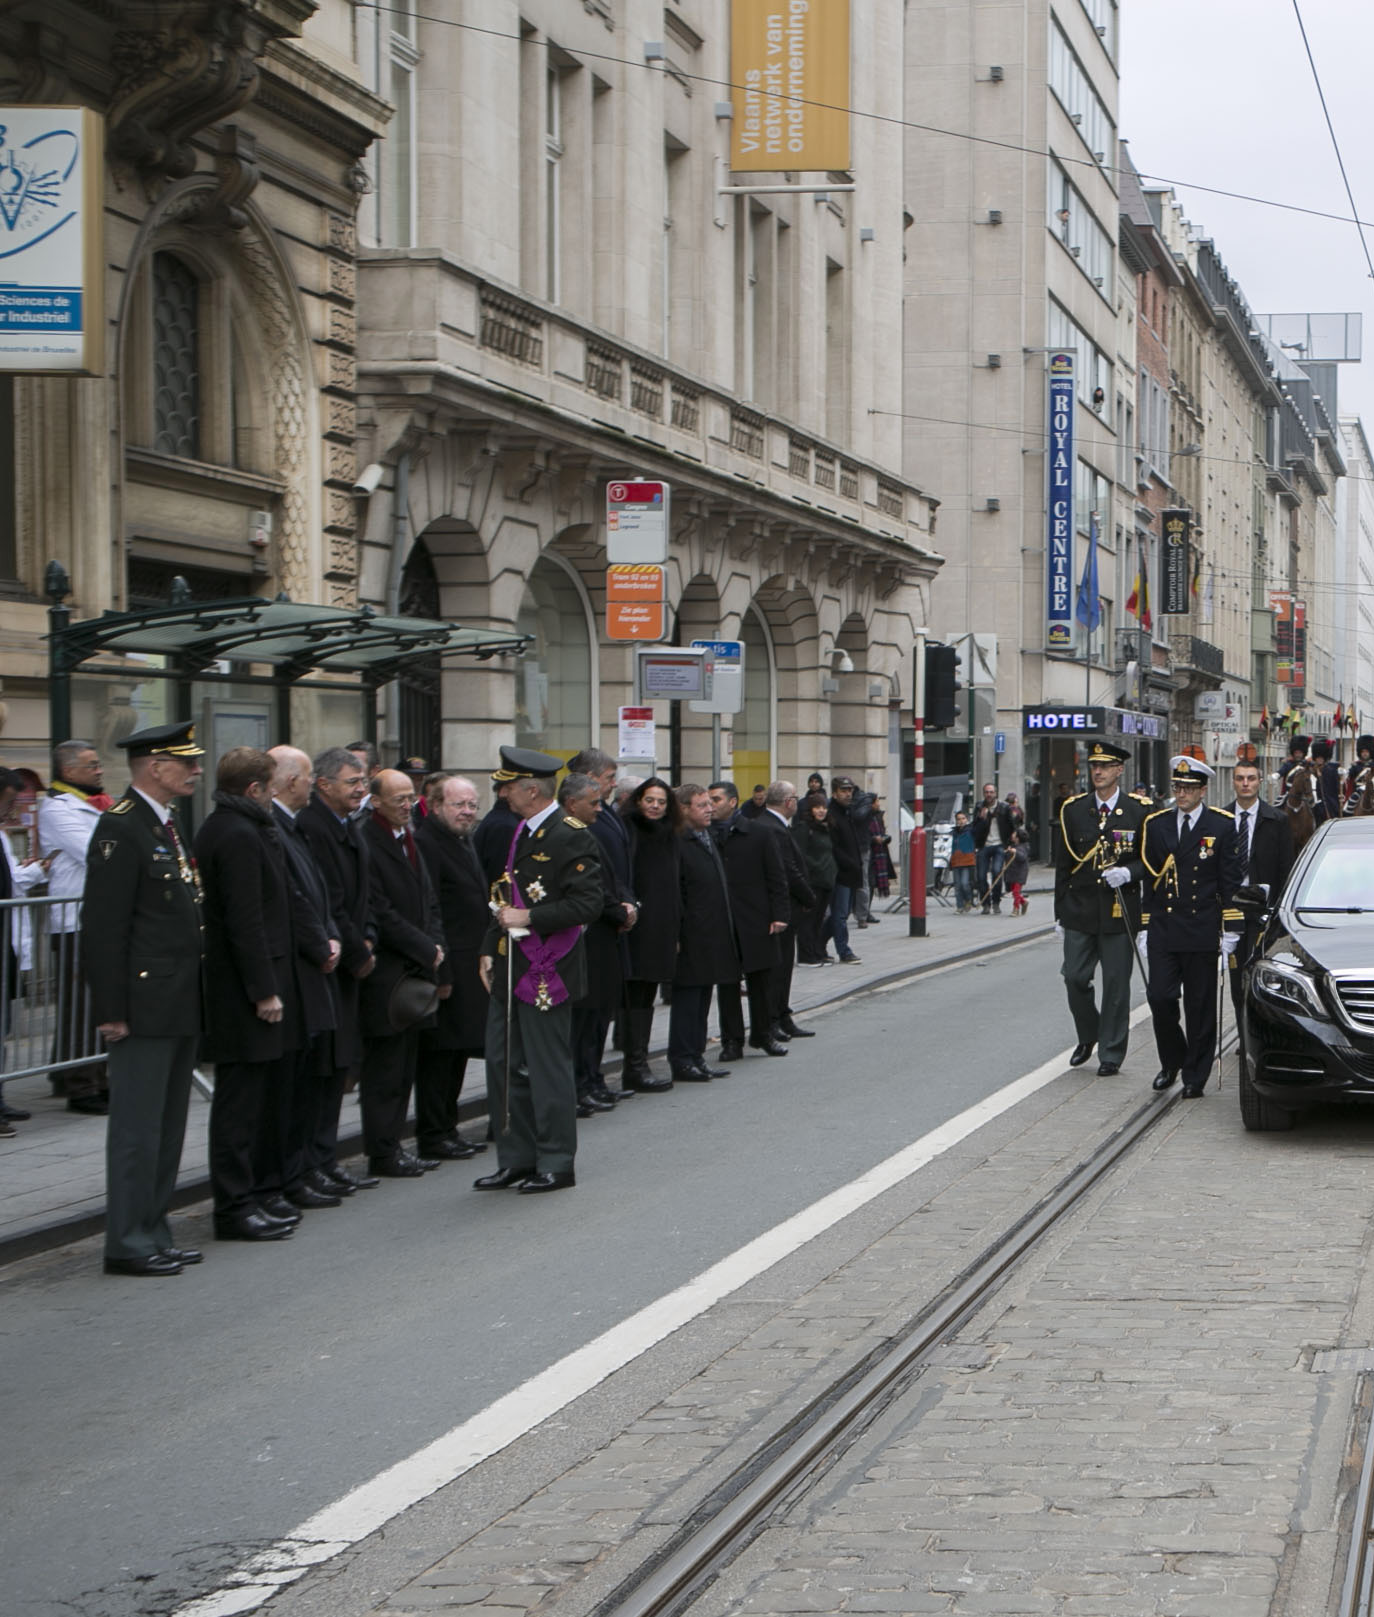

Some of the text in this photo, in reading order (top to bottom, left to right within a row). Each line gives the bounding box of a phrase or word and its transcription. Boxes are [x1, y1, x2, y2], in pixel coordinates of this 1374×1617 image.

[764, 14, 783, 153] netwerk van
[740, 69, 760, 153] Vlaams
[0, 294, 71, 307] Sciences de
[8, 310, 71, 323] Industriel
[1053, 394, 1069, 611] ROYAL CENTRE
[1028, 713, 1098, 729] HOTEL
